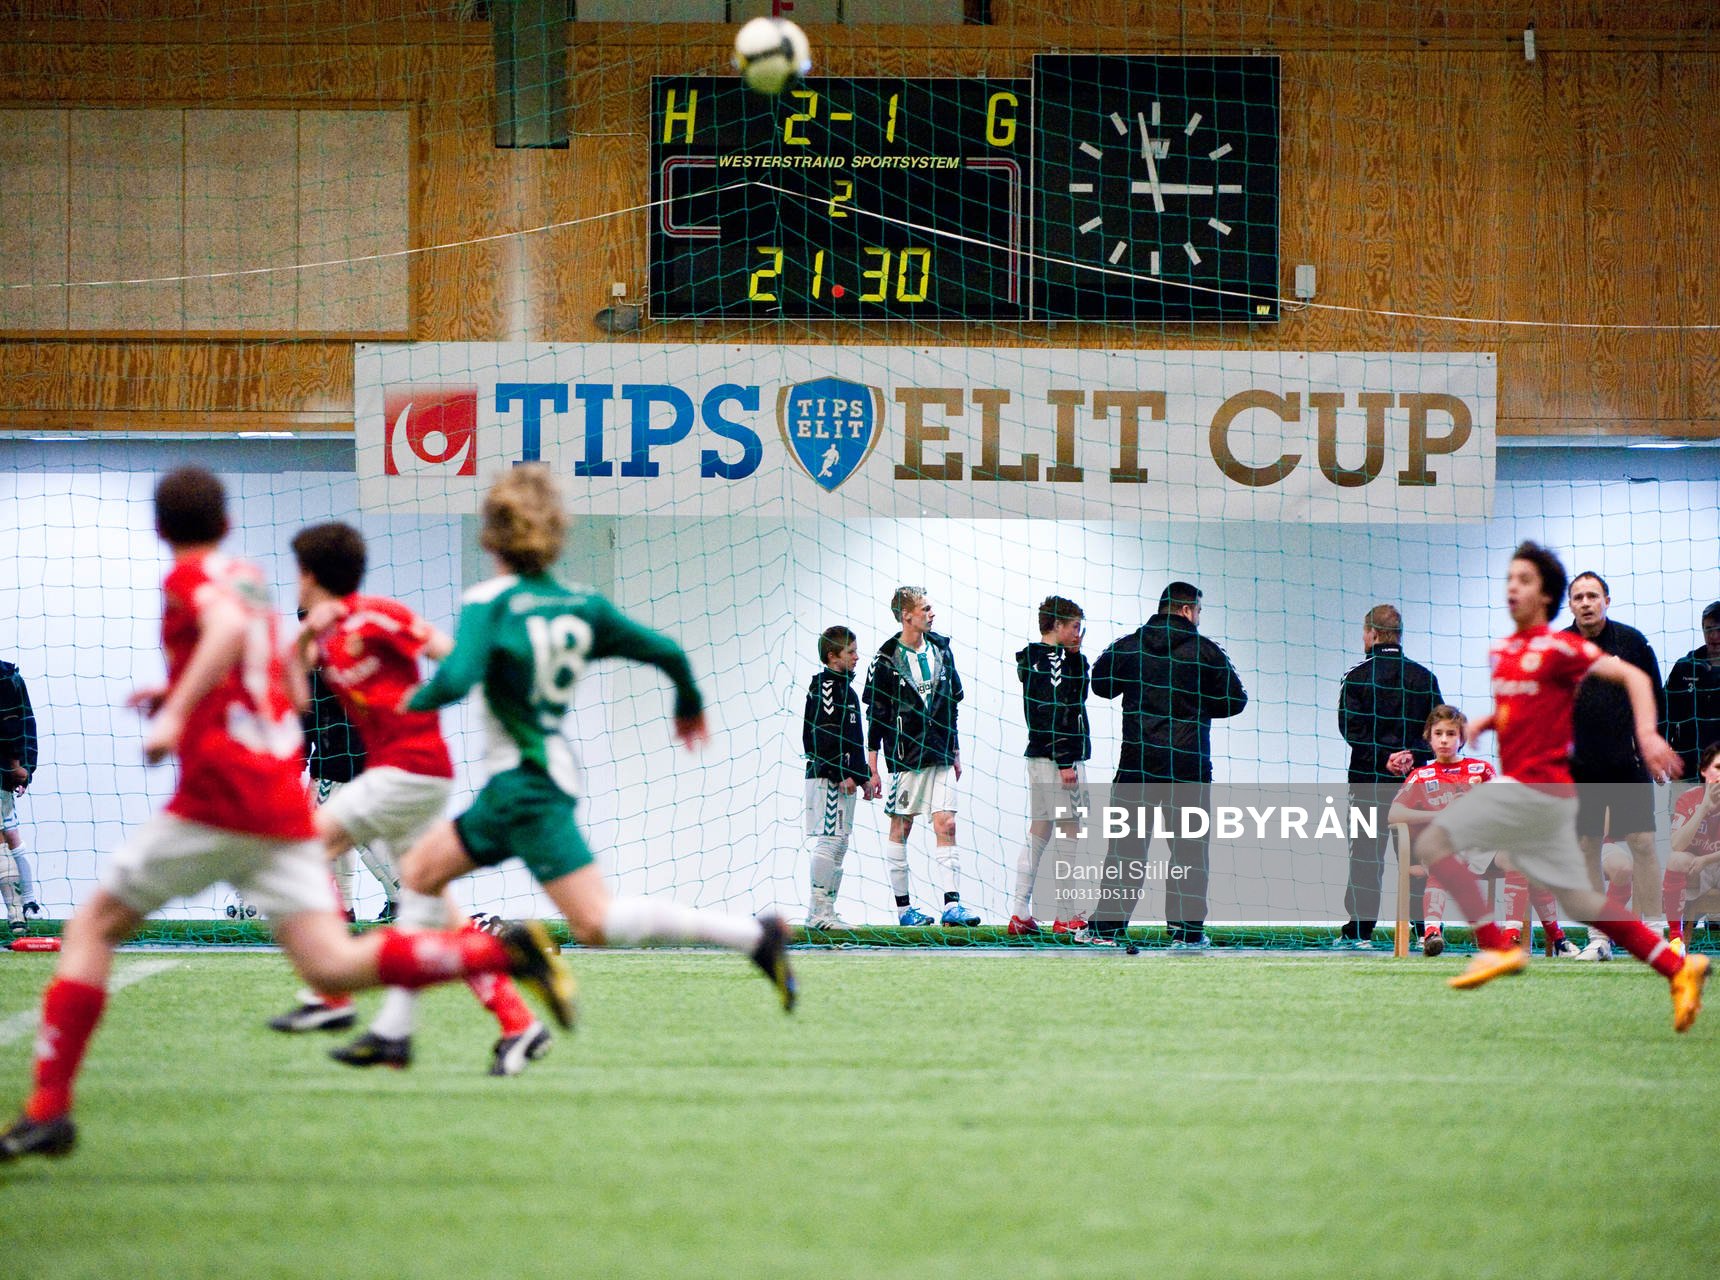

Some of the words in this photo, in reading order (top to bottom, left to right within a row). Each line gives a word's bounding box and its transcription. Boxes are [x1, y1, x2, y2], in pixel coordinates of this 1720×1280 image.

[663, 89, 698, 144] H
[985, 92, 1019, 147] G
[718, 155, 846, 169] WESTERSTRAND
[850, 156, 960, 169] SPORTSYSTEM
[828, 180, 853, 217] 2
[797, 398, 863, 418] TIPS
[495, 383, 763, 480] TIPS
[894, 387, 1166, 483] ELIT
[1208, 389, 1473, 487] CUP
[797, 420, 864, 439] ELIT
[525, 613, 593, 705] 18
[898, 790, 910, 809] 4
